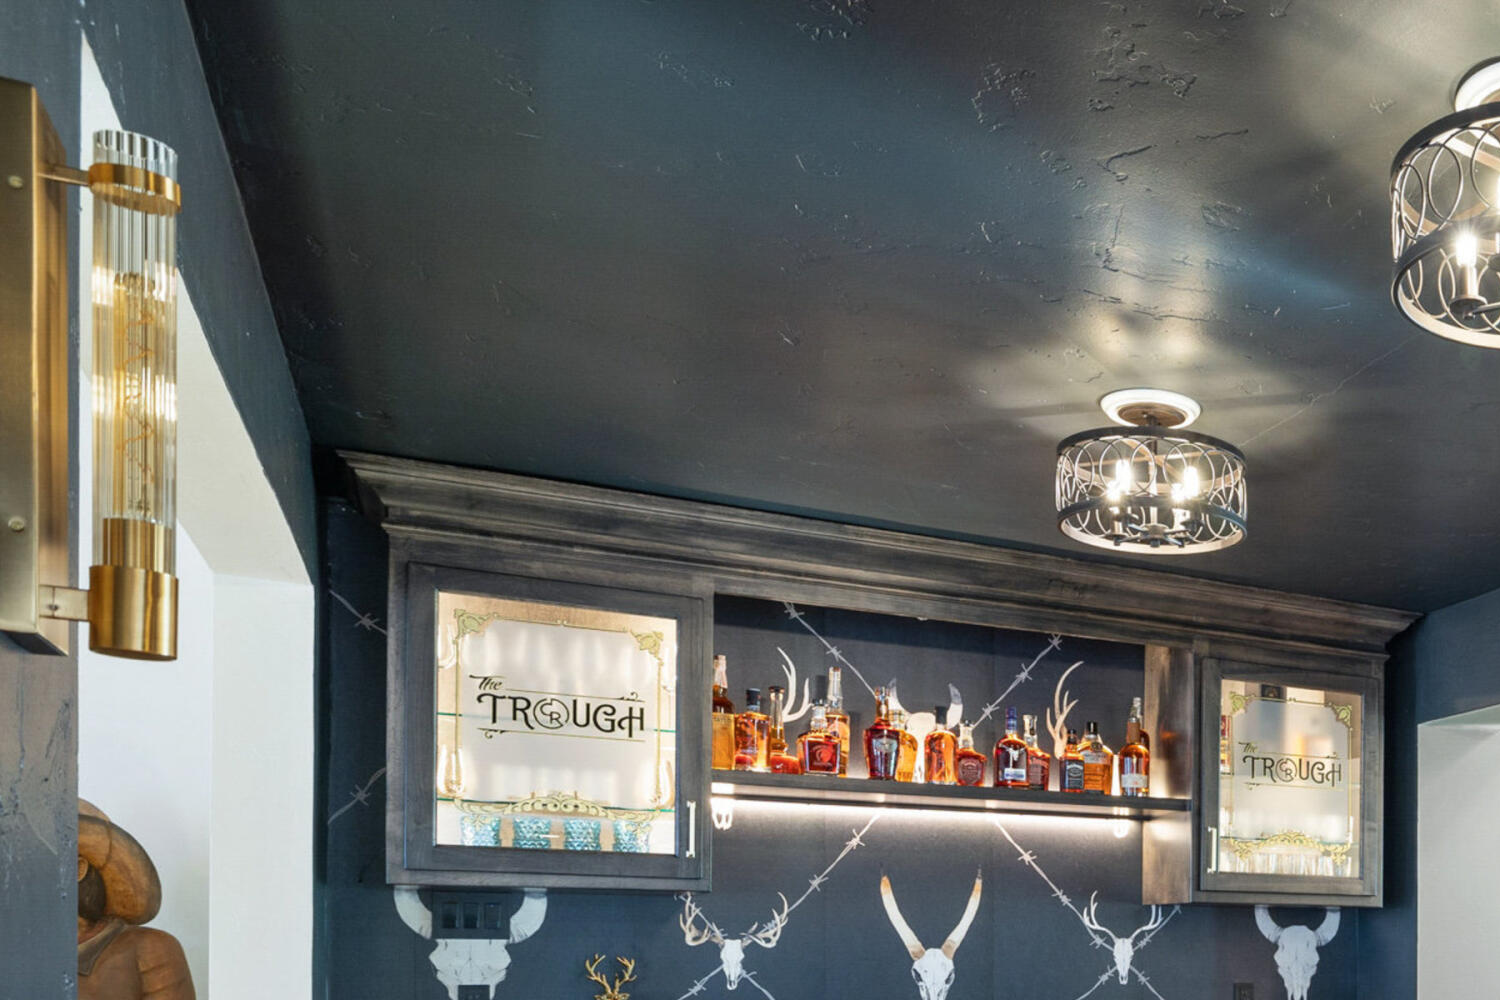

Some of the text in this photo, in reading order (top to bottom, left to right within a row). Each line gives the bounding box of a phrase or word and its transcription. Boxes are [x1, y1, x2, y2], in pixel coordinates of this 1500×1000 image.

[469, 674, 504, 691] The
[476, 693, 645, 738] TROUGH
[1238, 741, 1258, 753] The
[1242, 755, 1342, 787] TROUGH
